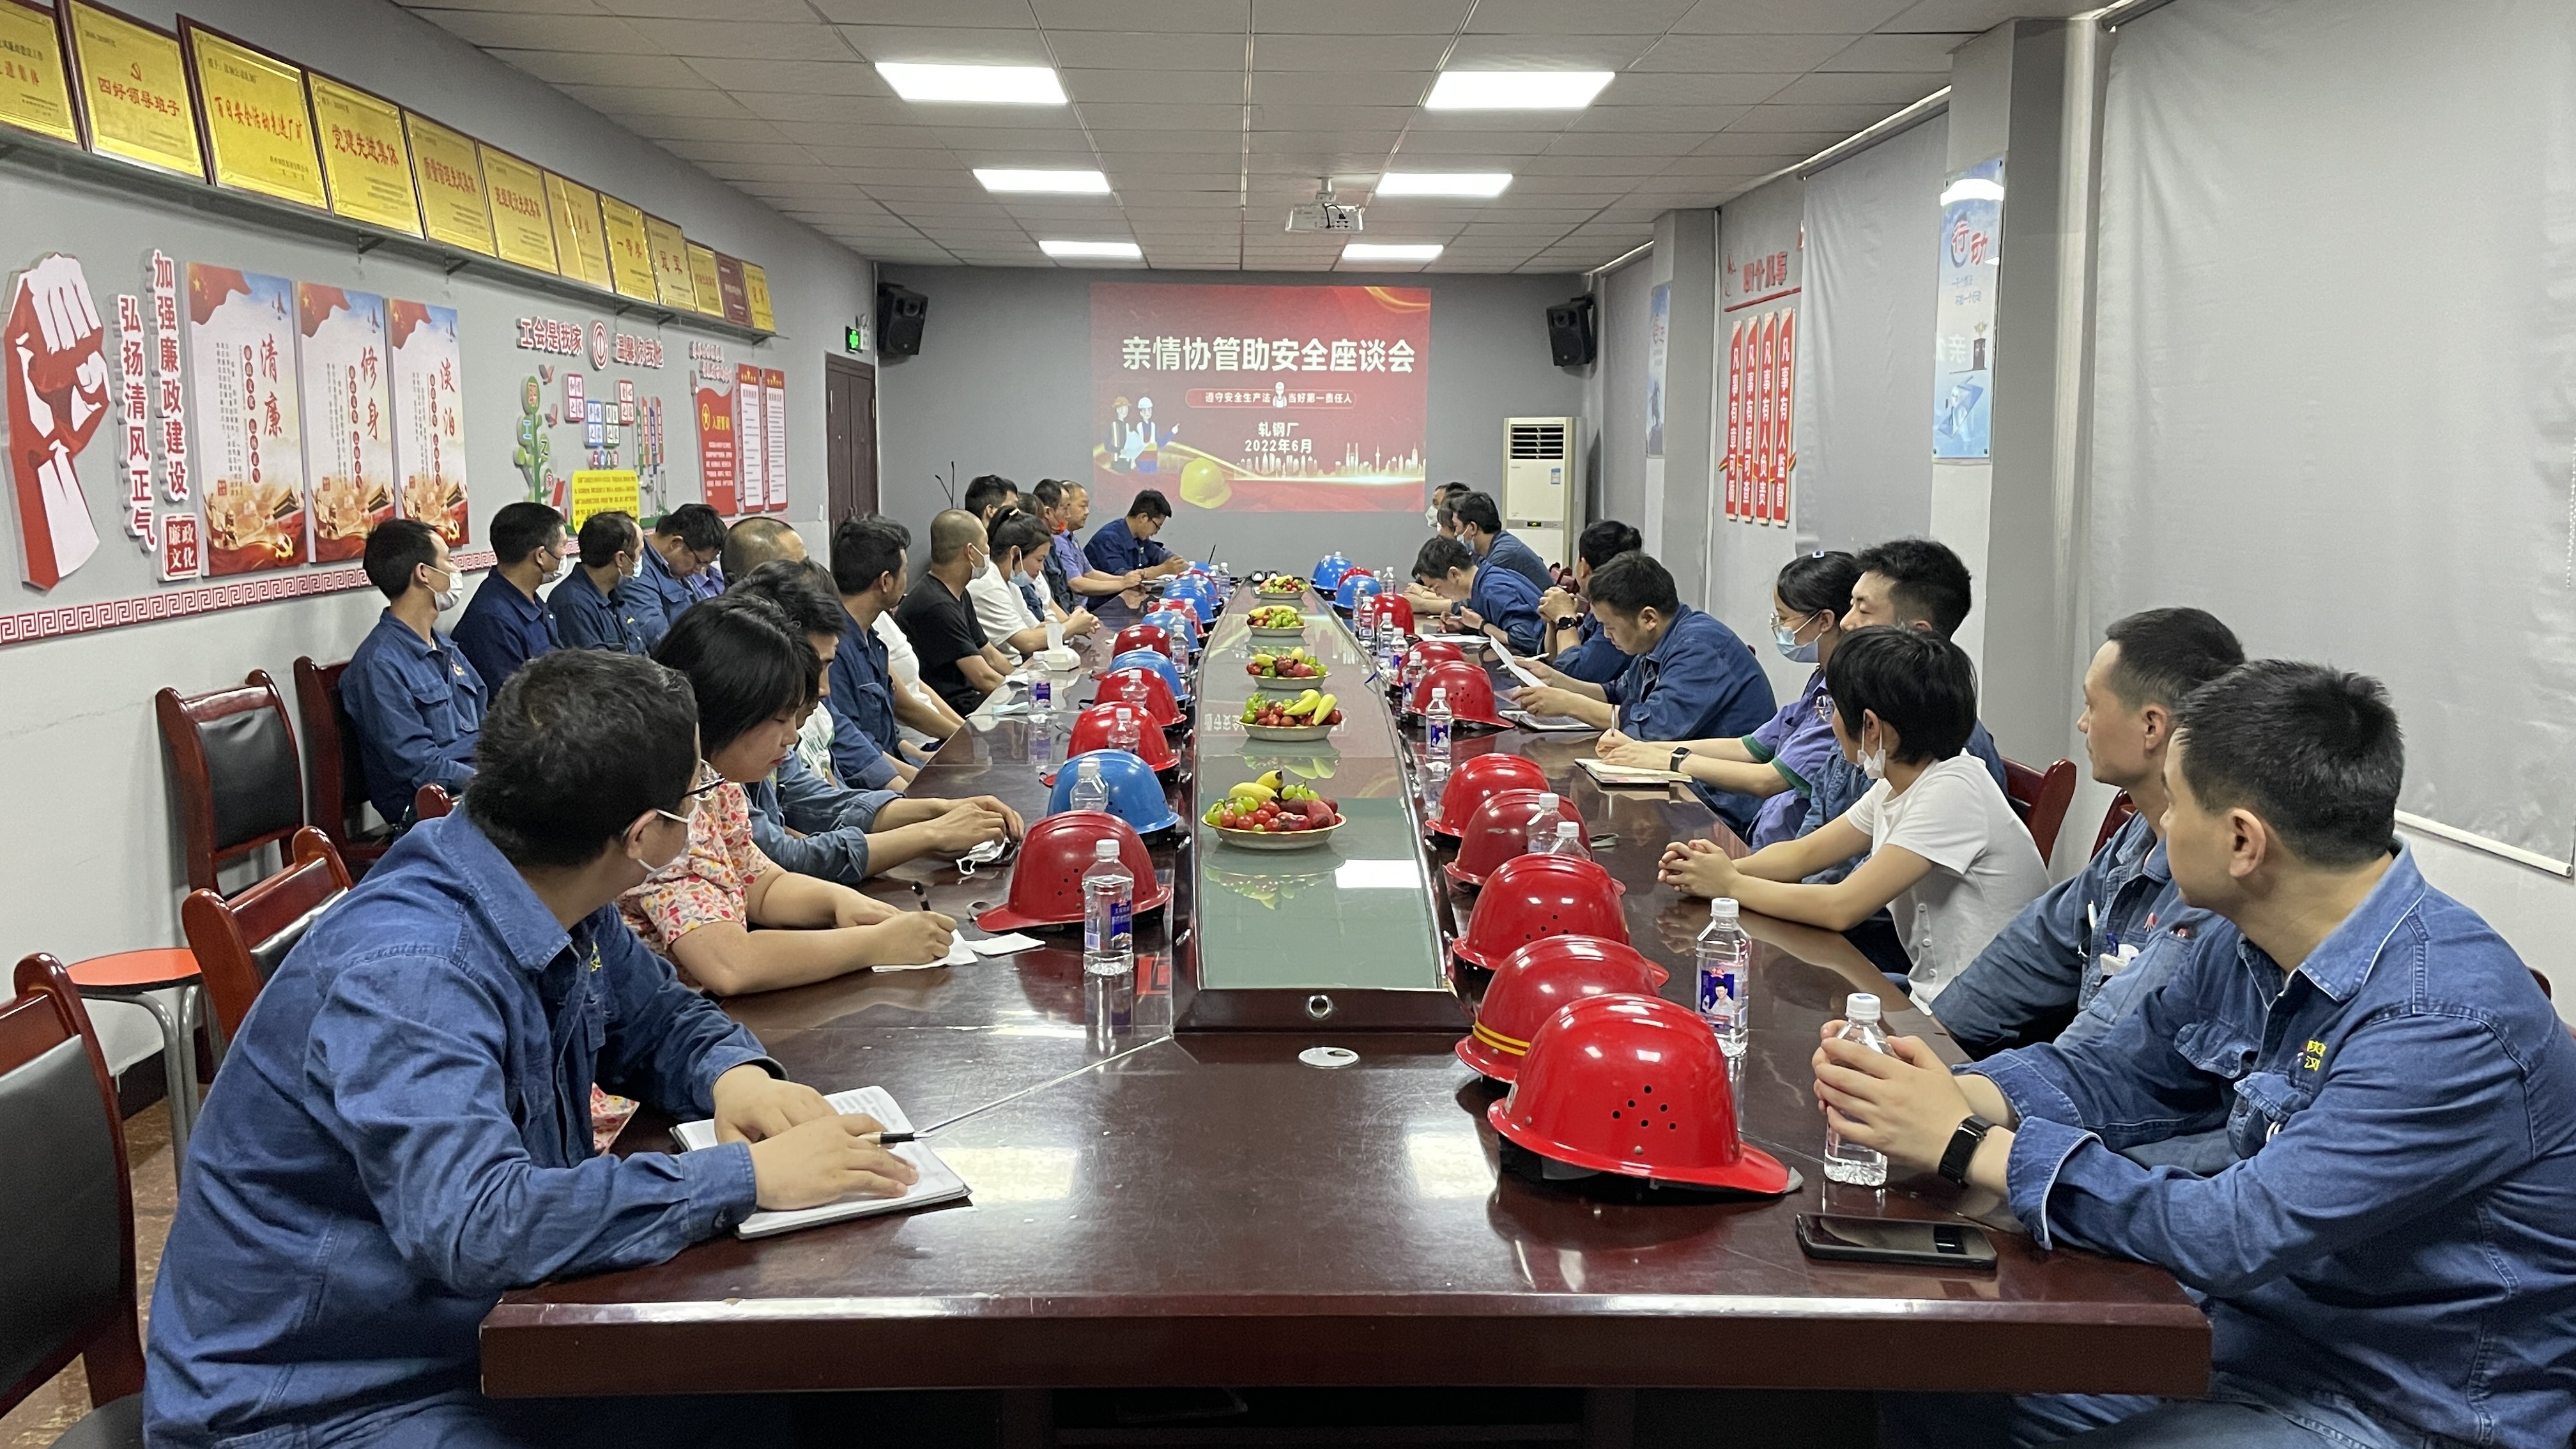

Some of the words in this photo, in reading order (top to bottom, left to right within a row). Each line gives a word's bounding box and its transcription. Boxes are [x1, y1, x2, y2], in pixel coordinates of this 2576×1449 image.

[98, 77, 180, 116] 四好领导班子
[332, 123, 399, 168] 党建先进集体
[1952, 220, 1988, 266] 行动
[521, 316, 583, 355] 工会是我家
[1122, 335, 1415, 373] 亲情协管助安全座谈会
[154, 250, 188, 500] 加强廉政建设
[260, 333, 282, 439] 清廉
[361, 346, 378, 441] 修身
[1205, 392, 1271, 404] 遵守安全生产法
[1288, 393, 1353, 404] 当好第一责任人
[119, 296, 156, 550] 弘扬清风正气
[1258, 422, 1299, 437] 轧钢厂
[1728, 348, 1739, 502] 凡事有章可循
[1743, 344, 1754, 503] 凡事有据可查
[1758, 341, 1772, 505] 凡事有人负责
[1776, 337, 1789, 508] 凡事有人监督
[1245, 439, 1312, 454] 2022年6月
[168, 524, 195, 546] 廉政
[169, 548, 196, 569] 文化
